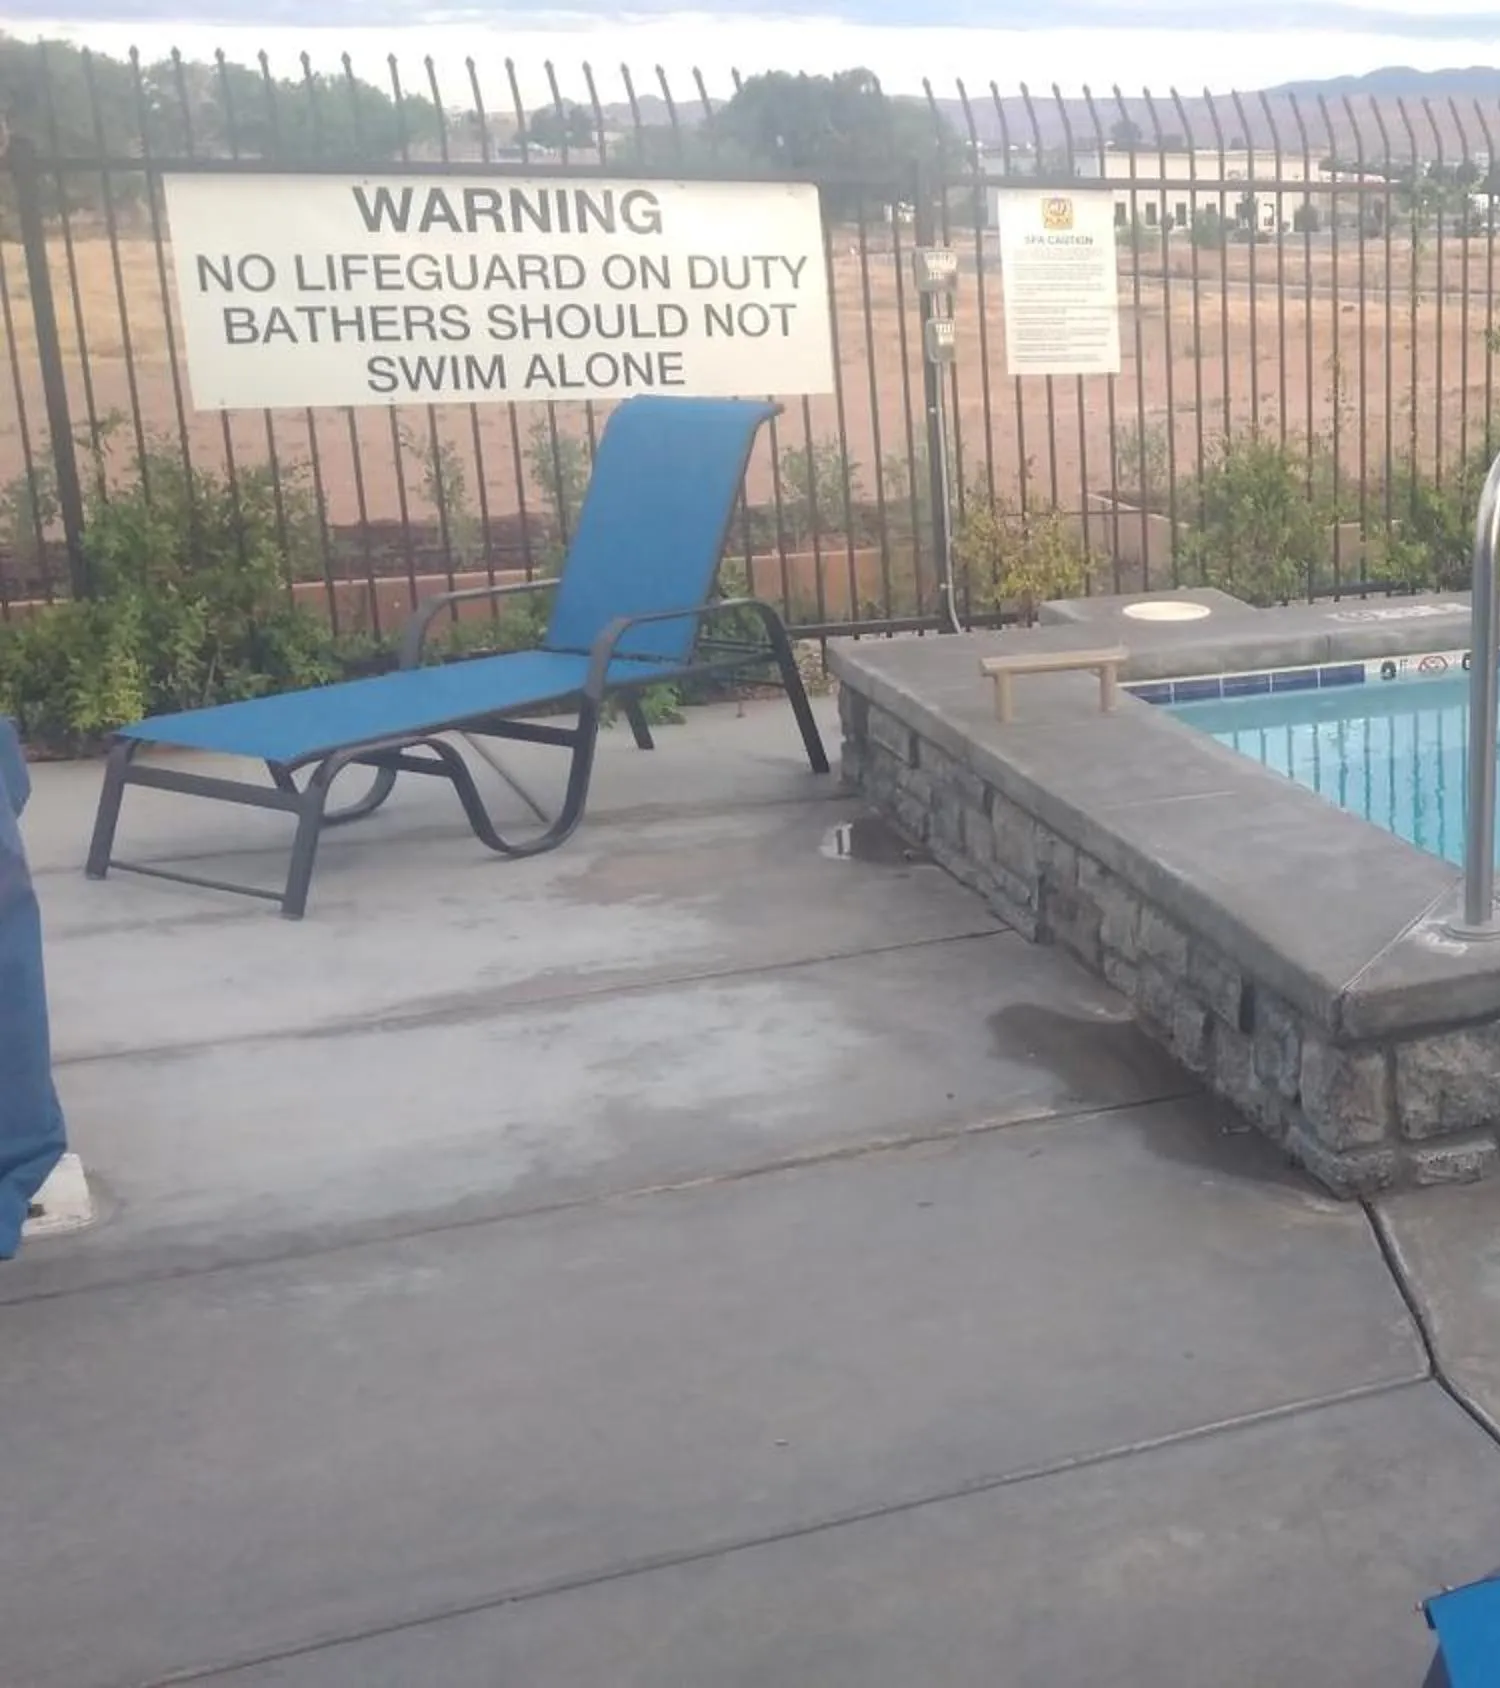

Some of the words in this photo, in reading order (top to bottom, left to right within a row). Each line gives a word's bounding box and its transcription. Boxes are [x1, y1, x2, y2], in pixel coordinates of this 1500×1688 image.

[352, 186, 663, 234] WARNING
[197, 254, 275, 292] NO
[295, 254, 585, 291] LIFEGUARD
[603, 255, 670, 289] ON
[689, 256, 806, 289] DUTY
[224, 305, 470, 344] BATHERS
[488, 304, 687, 340] SHOULD
[705, 304, 796, 336] NOT
[368, 355, 506, 392] SWIM
[525, 352, 685, 388] ALONE
